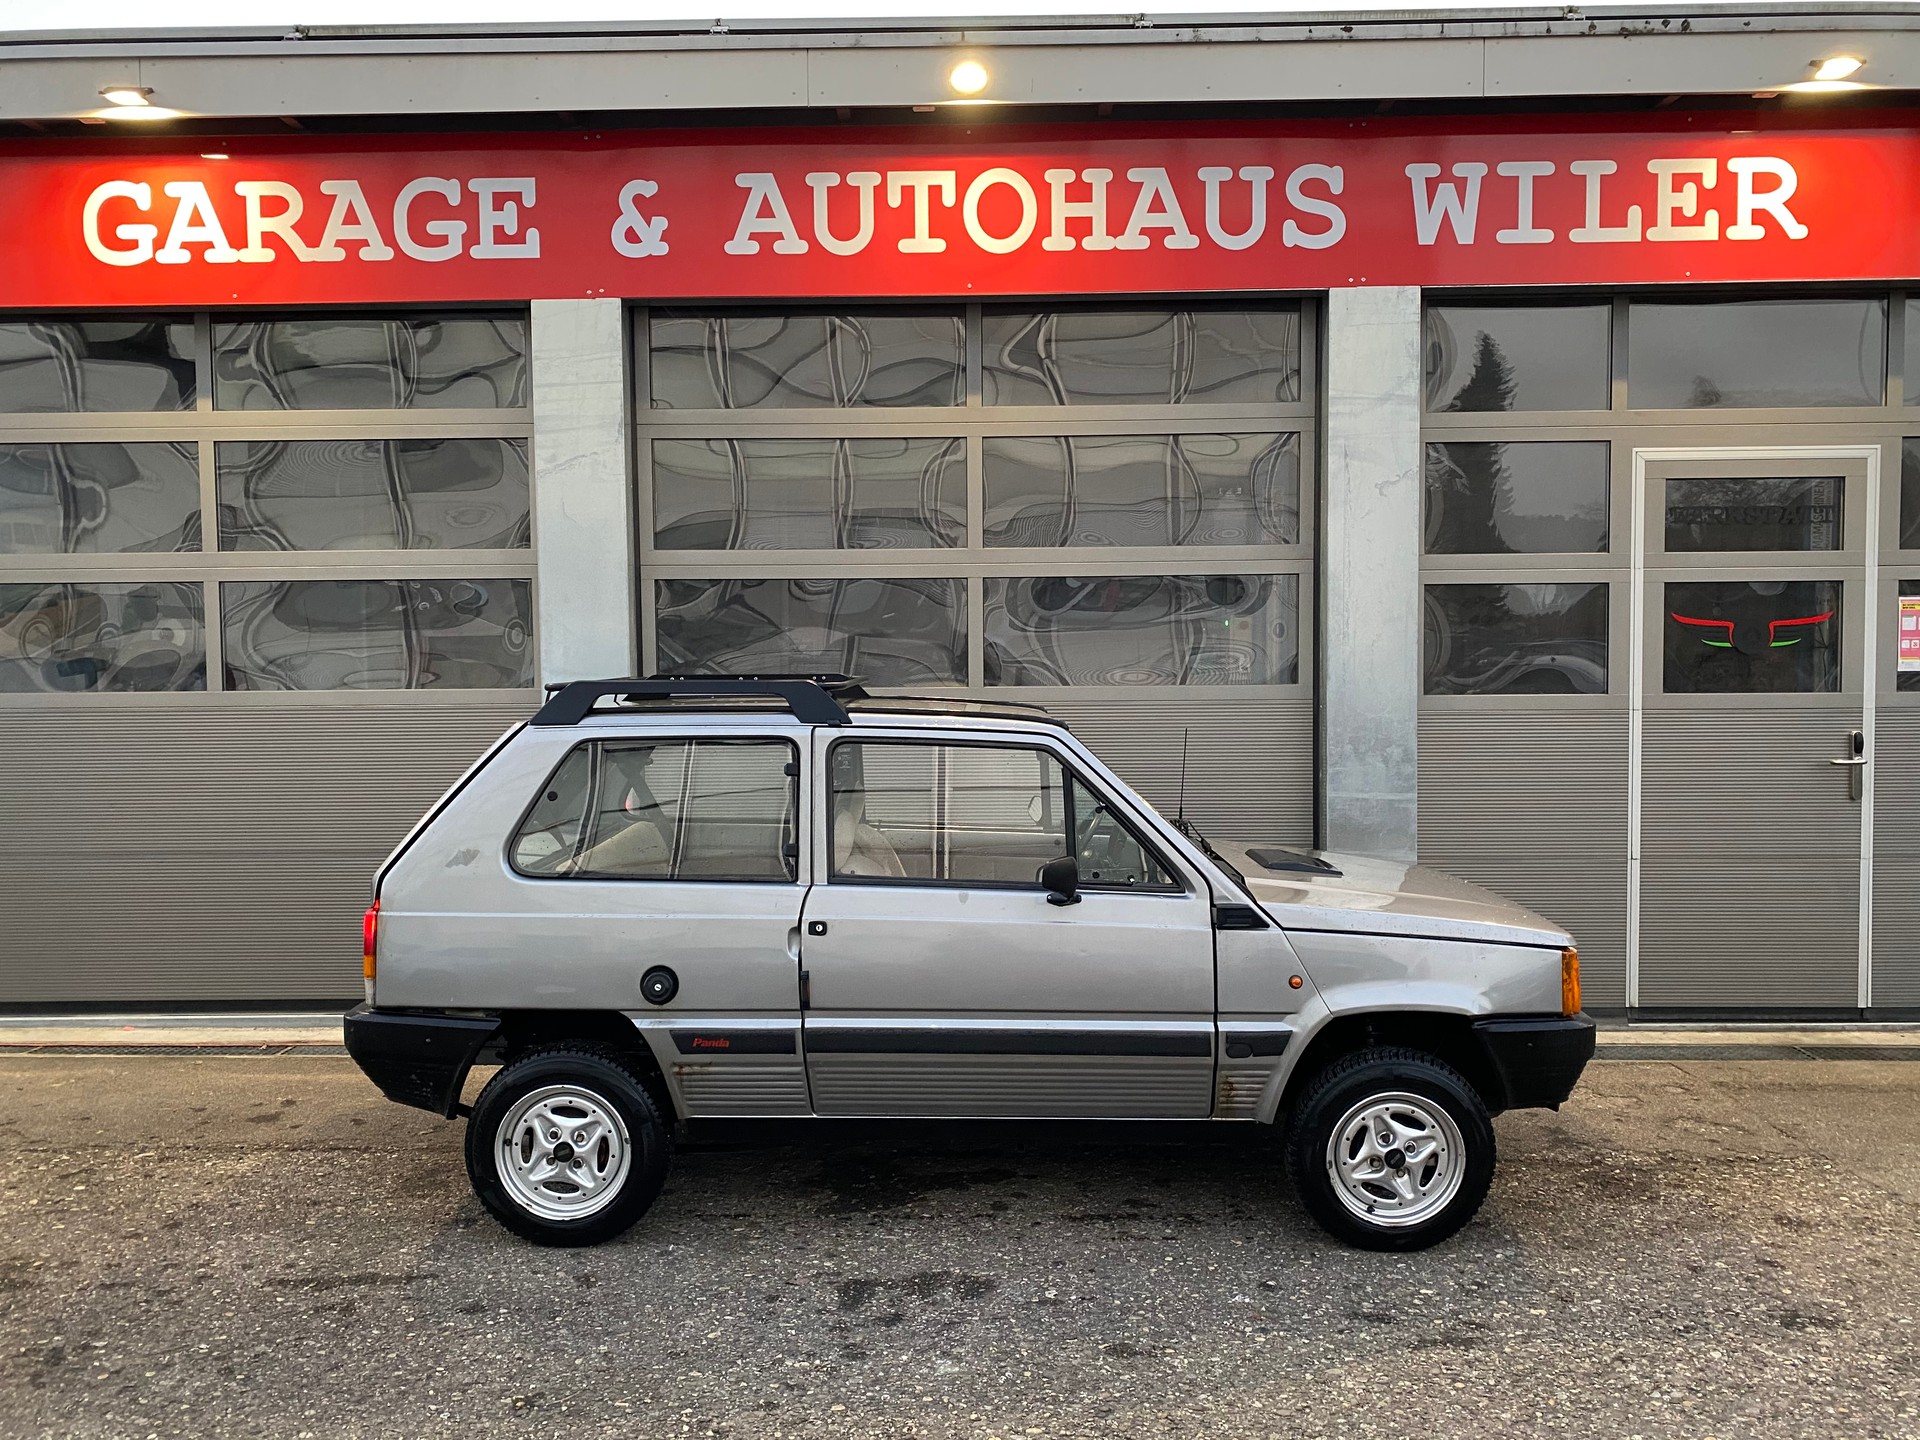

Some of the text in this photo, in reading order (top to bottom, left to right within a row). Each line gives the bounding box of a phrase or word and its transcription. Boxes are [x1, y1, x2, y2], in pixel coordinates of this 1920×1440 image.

[83, 156, 1809, 267] GARAGE & AUTOHAUS WILER
[692, 1038, 729, 1047] Panda
